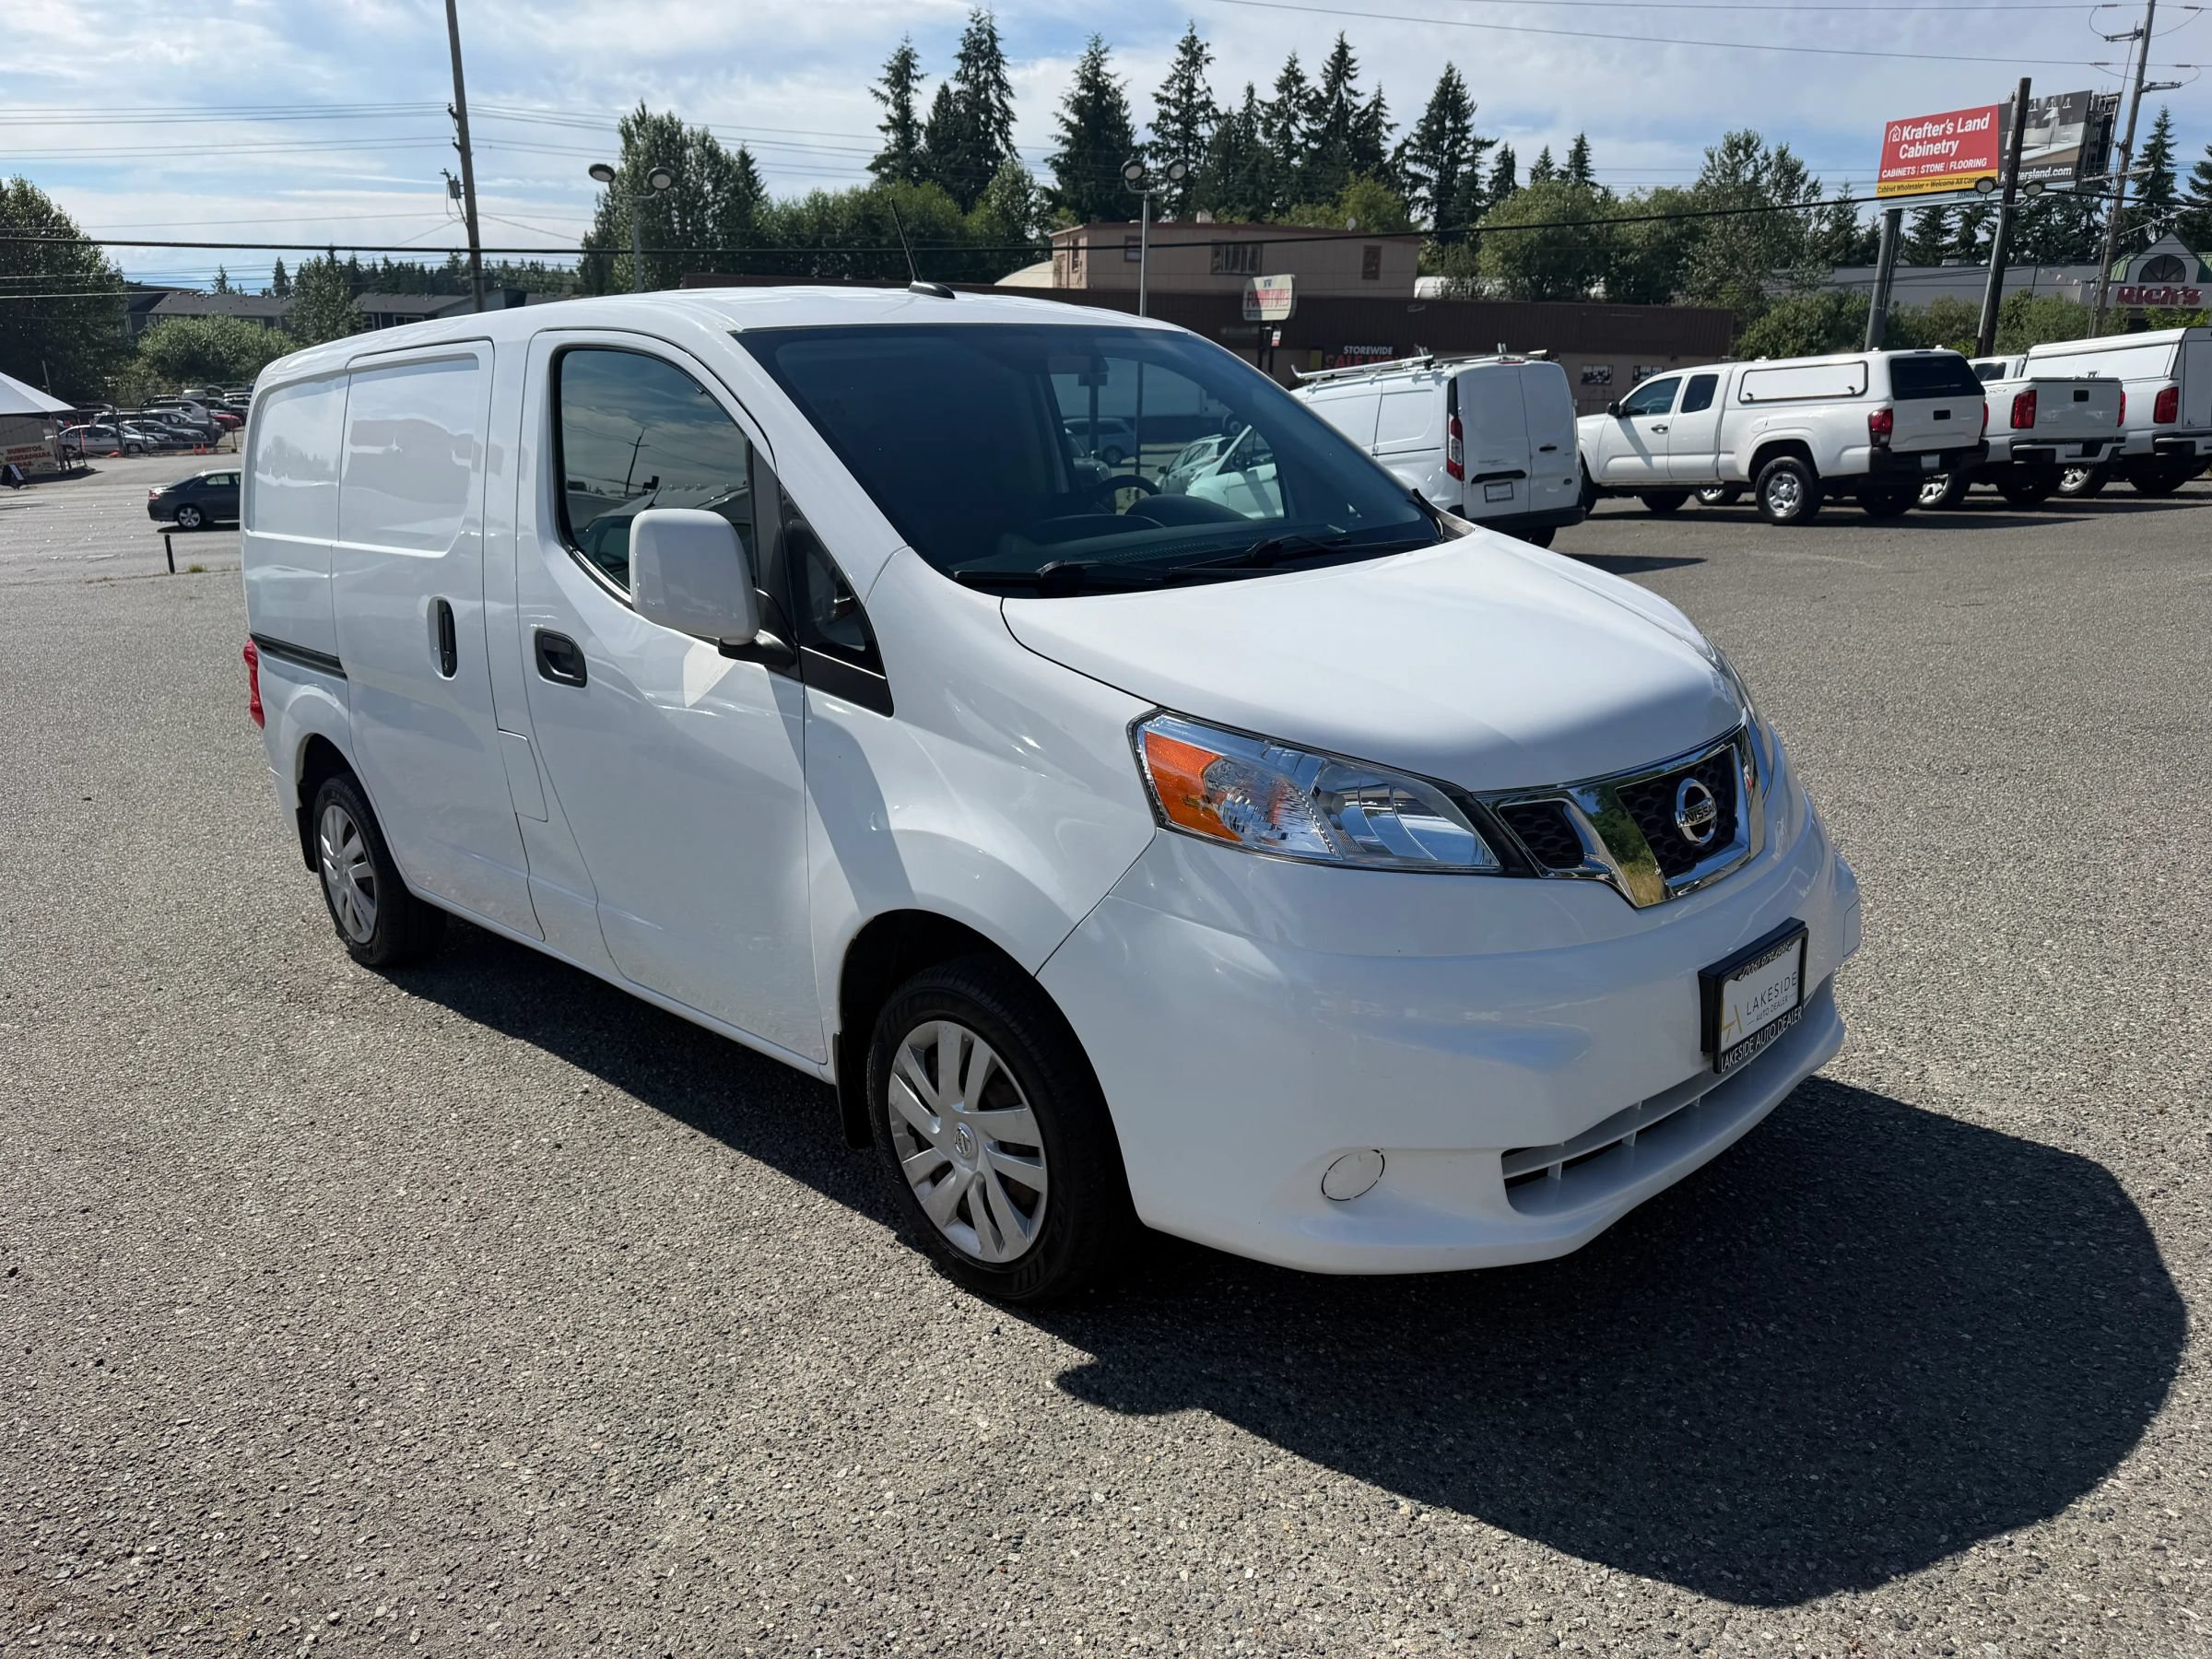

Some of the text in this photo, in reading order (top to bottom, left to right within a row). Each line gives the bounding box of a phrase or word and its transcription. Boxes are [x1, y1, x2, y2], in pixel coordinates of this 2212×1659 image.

[1901, 112, 1991, 141] Krafter's Land
[1899, 139, 1960, 159] Cabinetry
[1881, 158, 1987, 179] CABINETS STONE FLOORING
[1877, 184, 1896, 194] Cabinet
[1896, 182, 1924, 193] Wholesaler
[1930, 179, 1955, 190] Welcome
[2116, 285, 2202, 305] Rich's
[1343, 346, 1394, 355] STOREWIDE
[1747, 971, 1797, 1016] LAKESIDE
[1756, 995, 1789, 1021] AUTO DEALER
[1721, 1006, 1803, 1073] LAKESIDE AUTO DEALER
